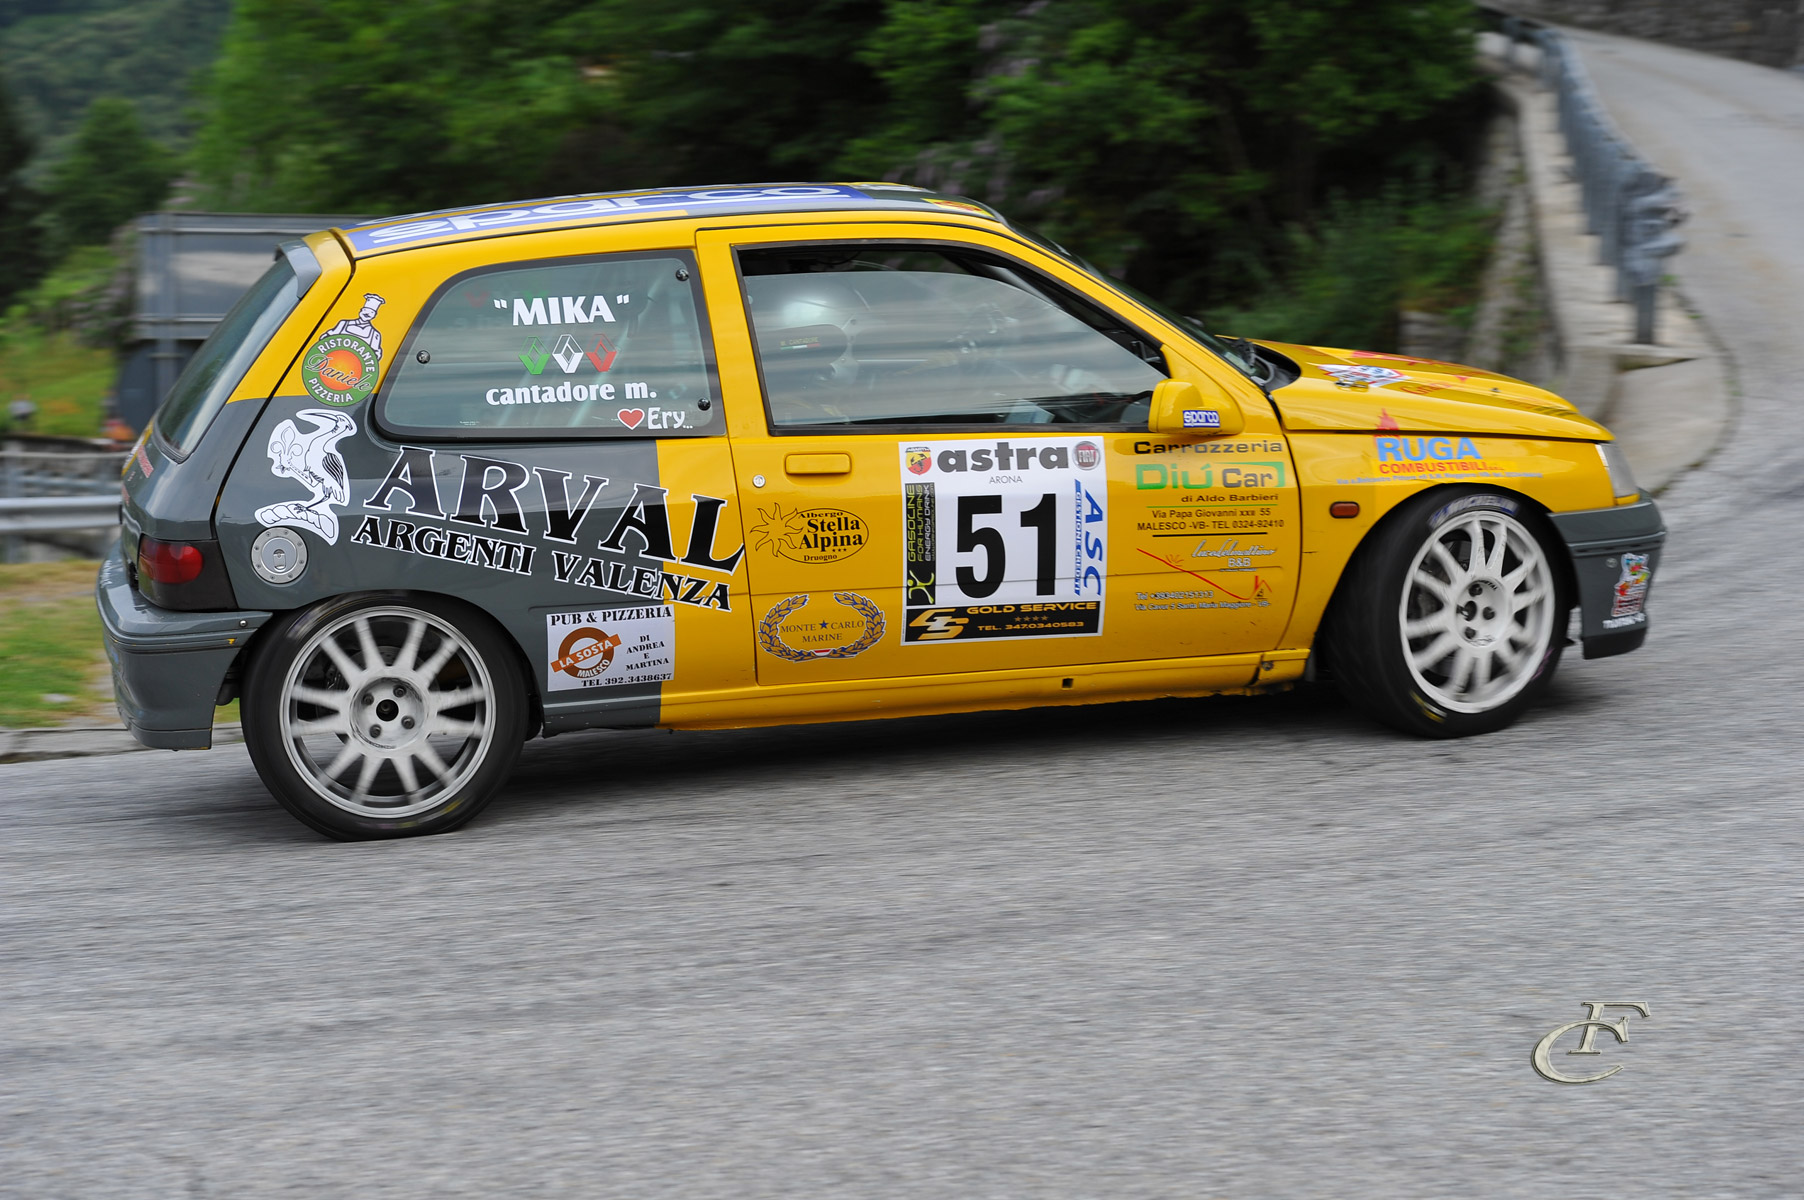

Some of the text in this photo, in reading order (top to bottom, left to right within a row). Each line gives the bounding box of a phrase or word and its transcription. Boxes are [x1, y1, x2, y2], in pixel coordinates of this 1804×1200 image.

[368, 186, 852, 243] sparco
[317, 338, 375, 373] RISTORANTE
[305, 353, 372, 392] Daniele
[308, 377, 353, 402] PIZZERIA
[486, 381, 657, 405] cantadore m.
[1183, 411, 1219, 427] sparco
[1134, 440, 1283, 454] Carrozzeria
[1376, 437, 1482, 461] RUGA
[937, 442, 1069, 473] astra
[1078, 449, 1095, 463] FIAT
[1379, 462, 1487, 474] COMBUSTIBILI
[989, 475, 1023, 484] ARONA
[1222, 468, 1273, 488] Car
[1229, 494, 1279, 502] Barbieri
[363, 445, 746, 575] ARVAL
[798, 511, 843, 519] Albergo
[1152, 510, 1167, 518] Via
[1170, 509, 1193, 519] Papa
[1195, 508, 1237, 518] Giovanni
[1259, 508, 1271, 516] 55
[807, 517, 860, 533] Stella
[906, 484, 917, 562] GASOLINE
[1137, 522, 1186, 530] MALESCO
[1212, 520, 1230, 529] TEL
[799, 532, 863, 552] Alpina
[956, 493, 1056, 598] 51
[1074, 492, 1082, 593] GESTIONE CREDITI
[1085, 489, 1104, 597] ASC
[350, 515, 733, 613] ARGENTI VALENZA
[804, 553, 838, 561] Druogno
[1228, 557, 1251, 568] B&B
[1136, 592, 1148, 600] Tel
[550, 606, 672, 626] PUB & PIZZERIA
[966, 602, 1097, 615] GOLD SERVICE
[781, 620, 864, 633] MONTE CARLO
[1004, 621, 1085, 631] 347.0340583
[639, 634, 650, 643] DI
[802, 633, 843, 643] MARINE
[559, 640, 613, 668] LA SOSTA
[626, 641, 665, 655] ANDREA
[644, 652, 650, 660] E
[577, 659, 611, 679] MALESCO
[625, 657, 670, 671] MARTINA
[581, 673, 672, 687] TEL 392.3438637
